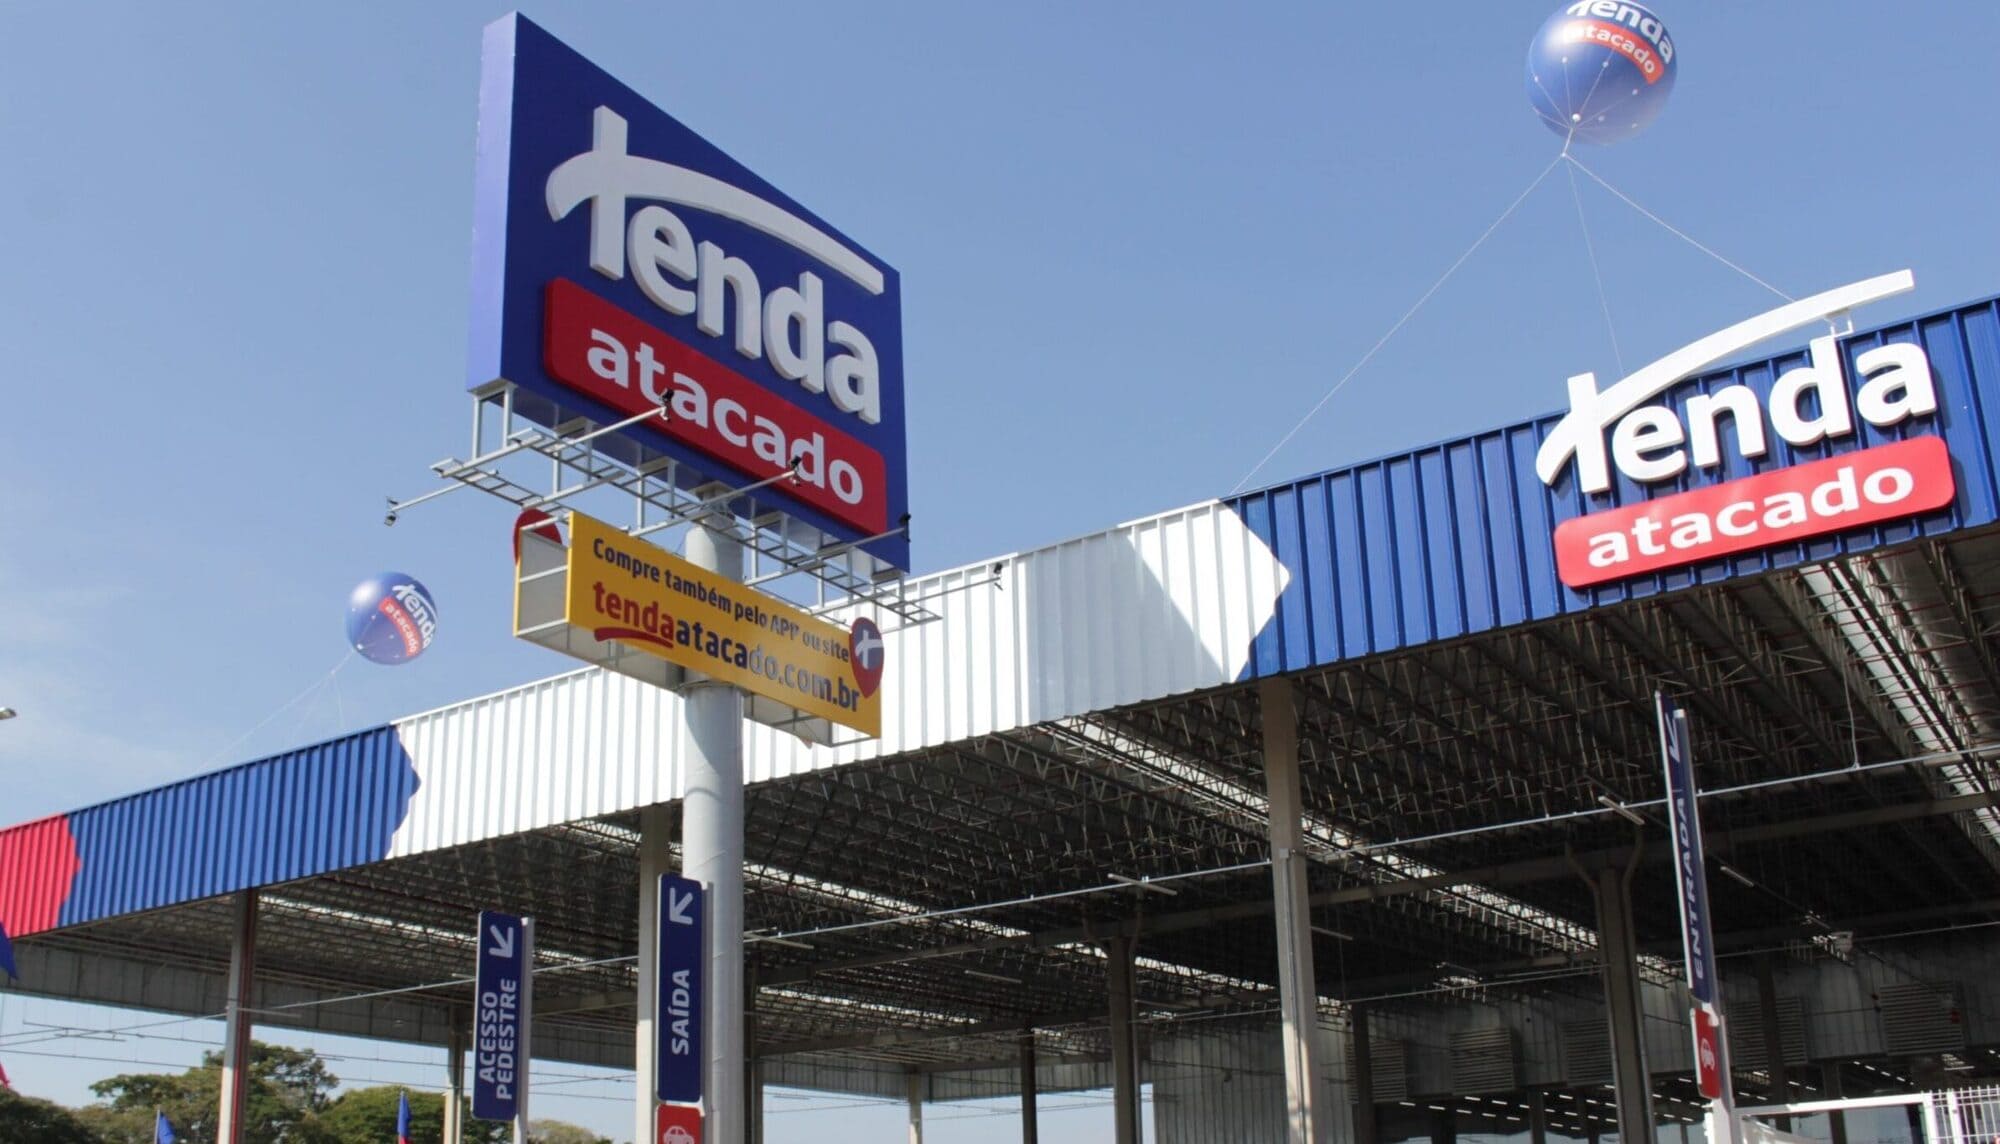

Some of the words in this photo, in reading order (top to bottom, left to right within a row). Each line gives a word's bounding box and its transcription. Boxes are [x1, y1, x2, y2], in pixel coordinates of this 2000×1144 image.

[545, 105, 884, 425] tenda
[587, 328, 863, 504] atacado
[1536, 268, 1937, 494] tenda
[1588, 466, 1914, 567] atacado
[392, 584, 437, 649] tenda
[593, 538, 660, 582] Compre
[665, 569, 732, 613] também
[735, 602, 768, 628] pelo
[770, 614, 800, 640] APP
[802, 631, 821, 651] ou
[822, 637, 850, 662] site
[593, 581, 860, 712] tendaatacado.com.br
[1677, 797, 1704, 980] ENTRADA
[479, 991, 498, 1083] ACESSO
[496, 978, 517, 1100] PEDESTRE
[668, 969, 690, 1056] SAÍDA
